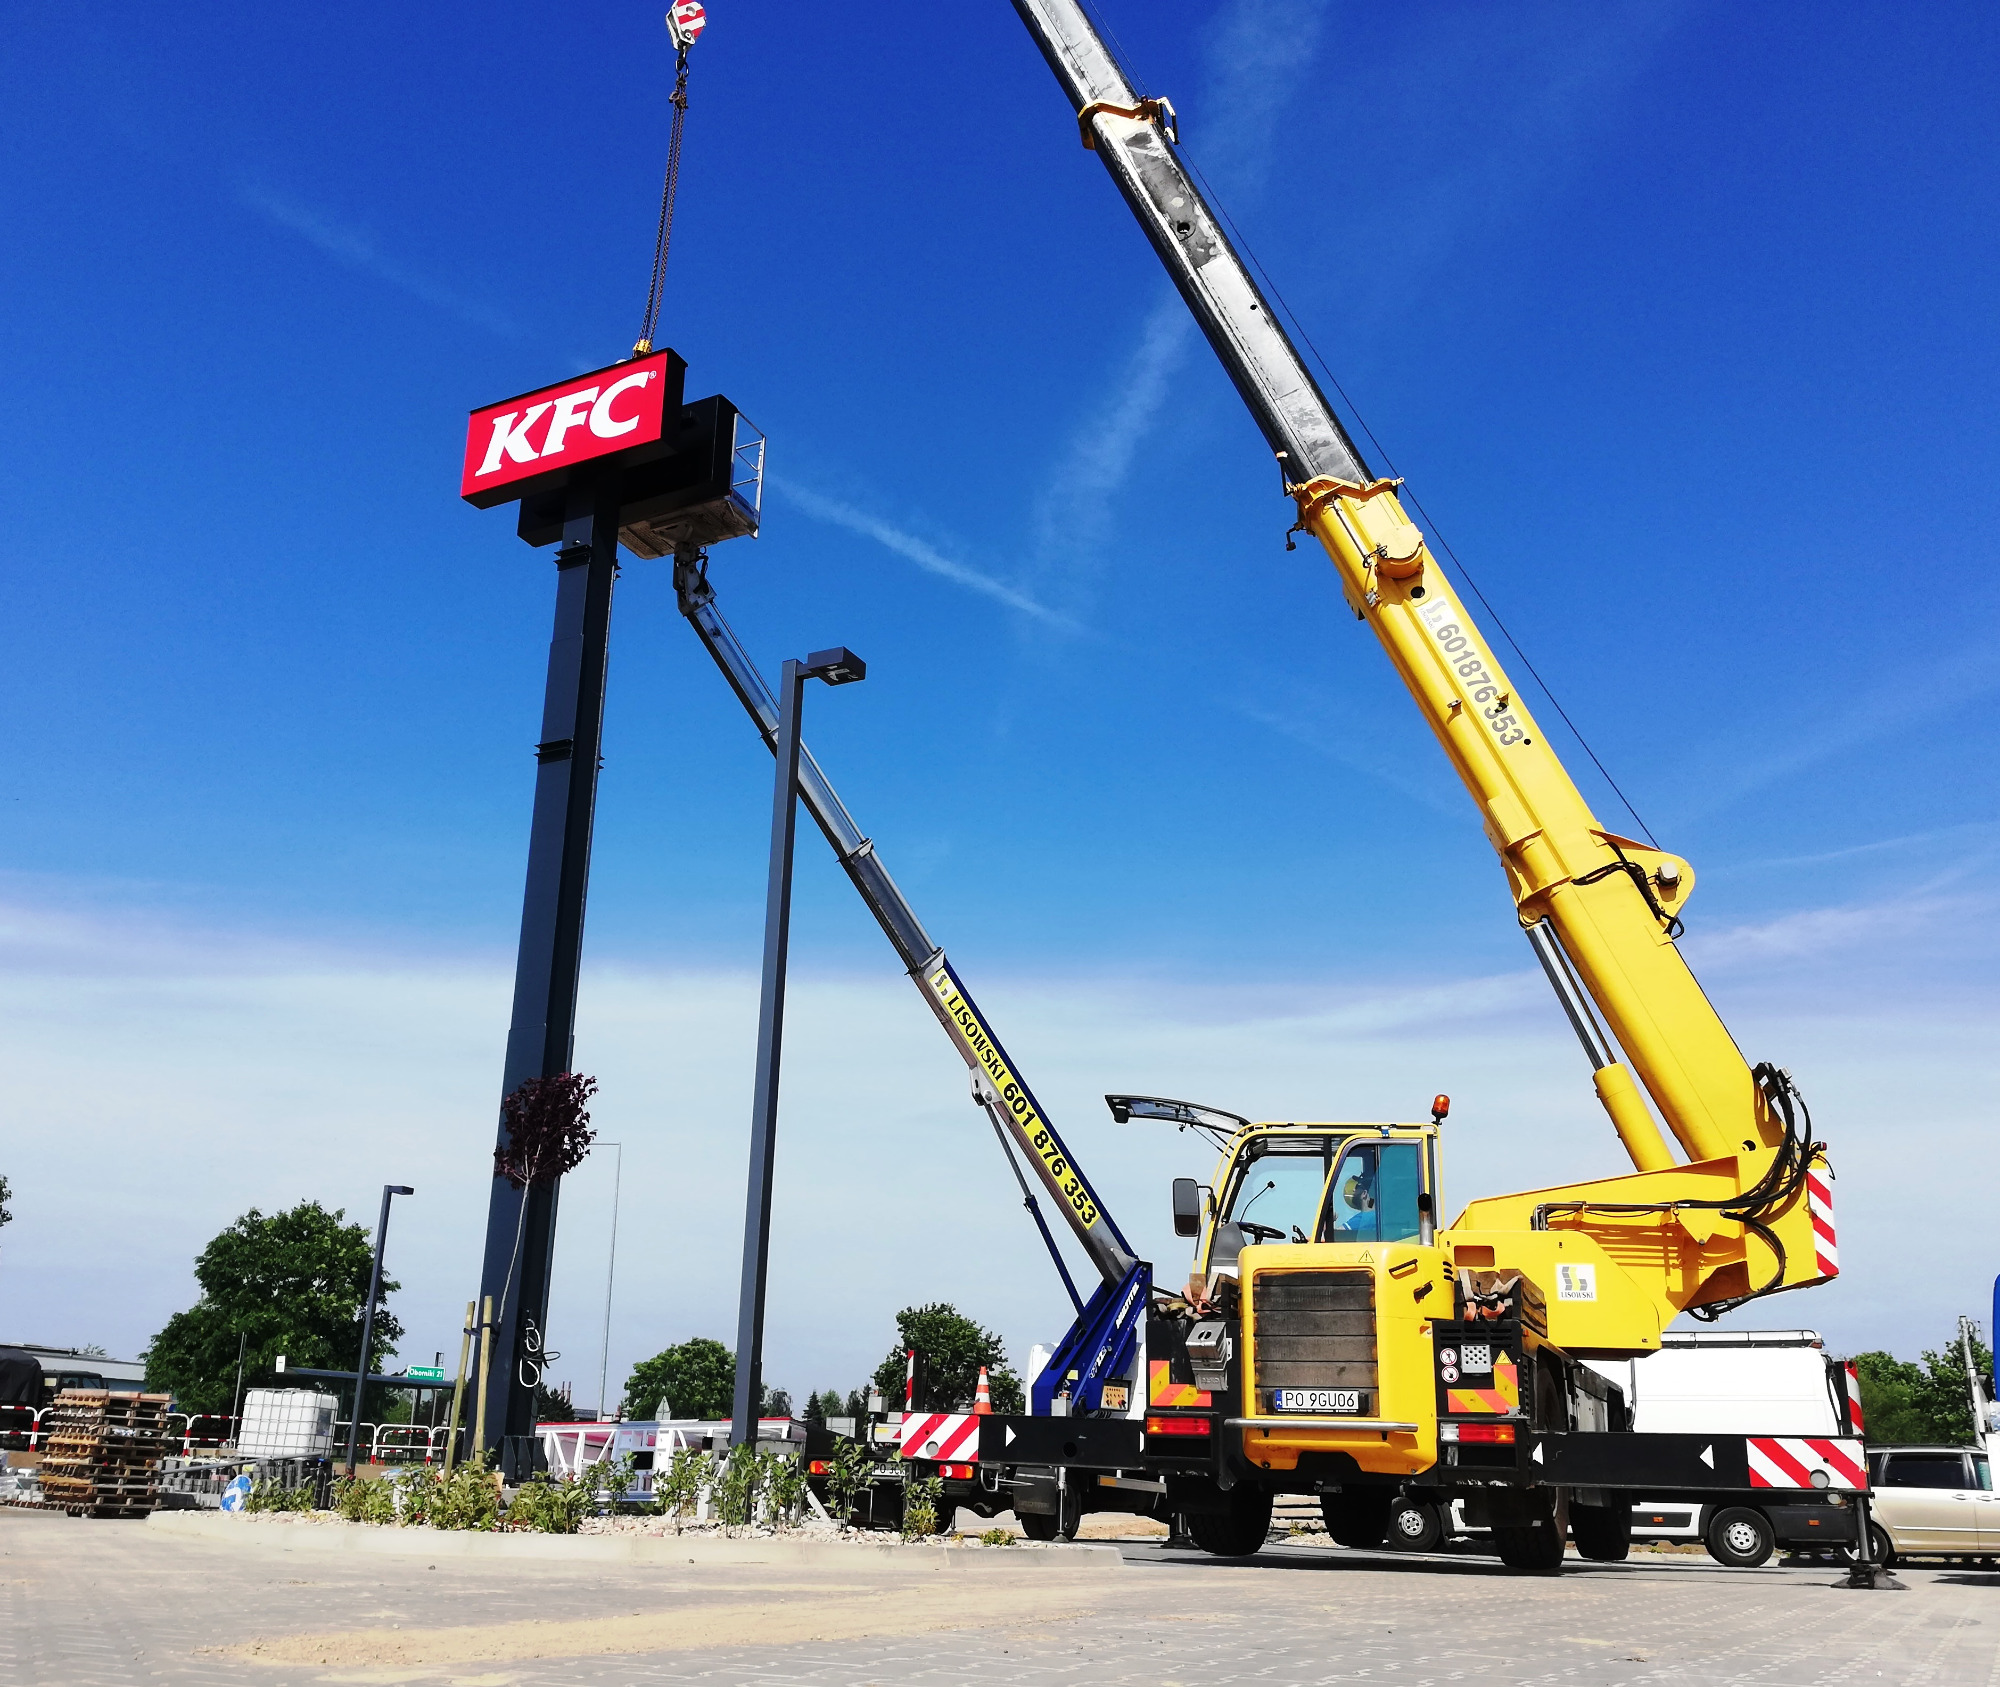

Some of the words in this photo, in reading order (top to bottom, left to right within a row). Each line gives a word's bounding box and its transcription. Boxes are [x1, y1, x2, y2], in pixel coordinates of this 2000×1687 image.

[475, 371, 649, 477] KFC
[947, 995, 1007, 1081] LISOWSKI
[1003, 1082, 1036, 1128] 601
[1033, 1129, 1067, 1177] 876
[1063, 1177, 1097, 1224] 353
[1560, 1291, 1594, 1299] LISOWSKI
[1285, 1392, 1304, 1407] PO
[1309, 1392, 1355, 1407] 9GU06
[873, 1463, 887, 1474] PO
